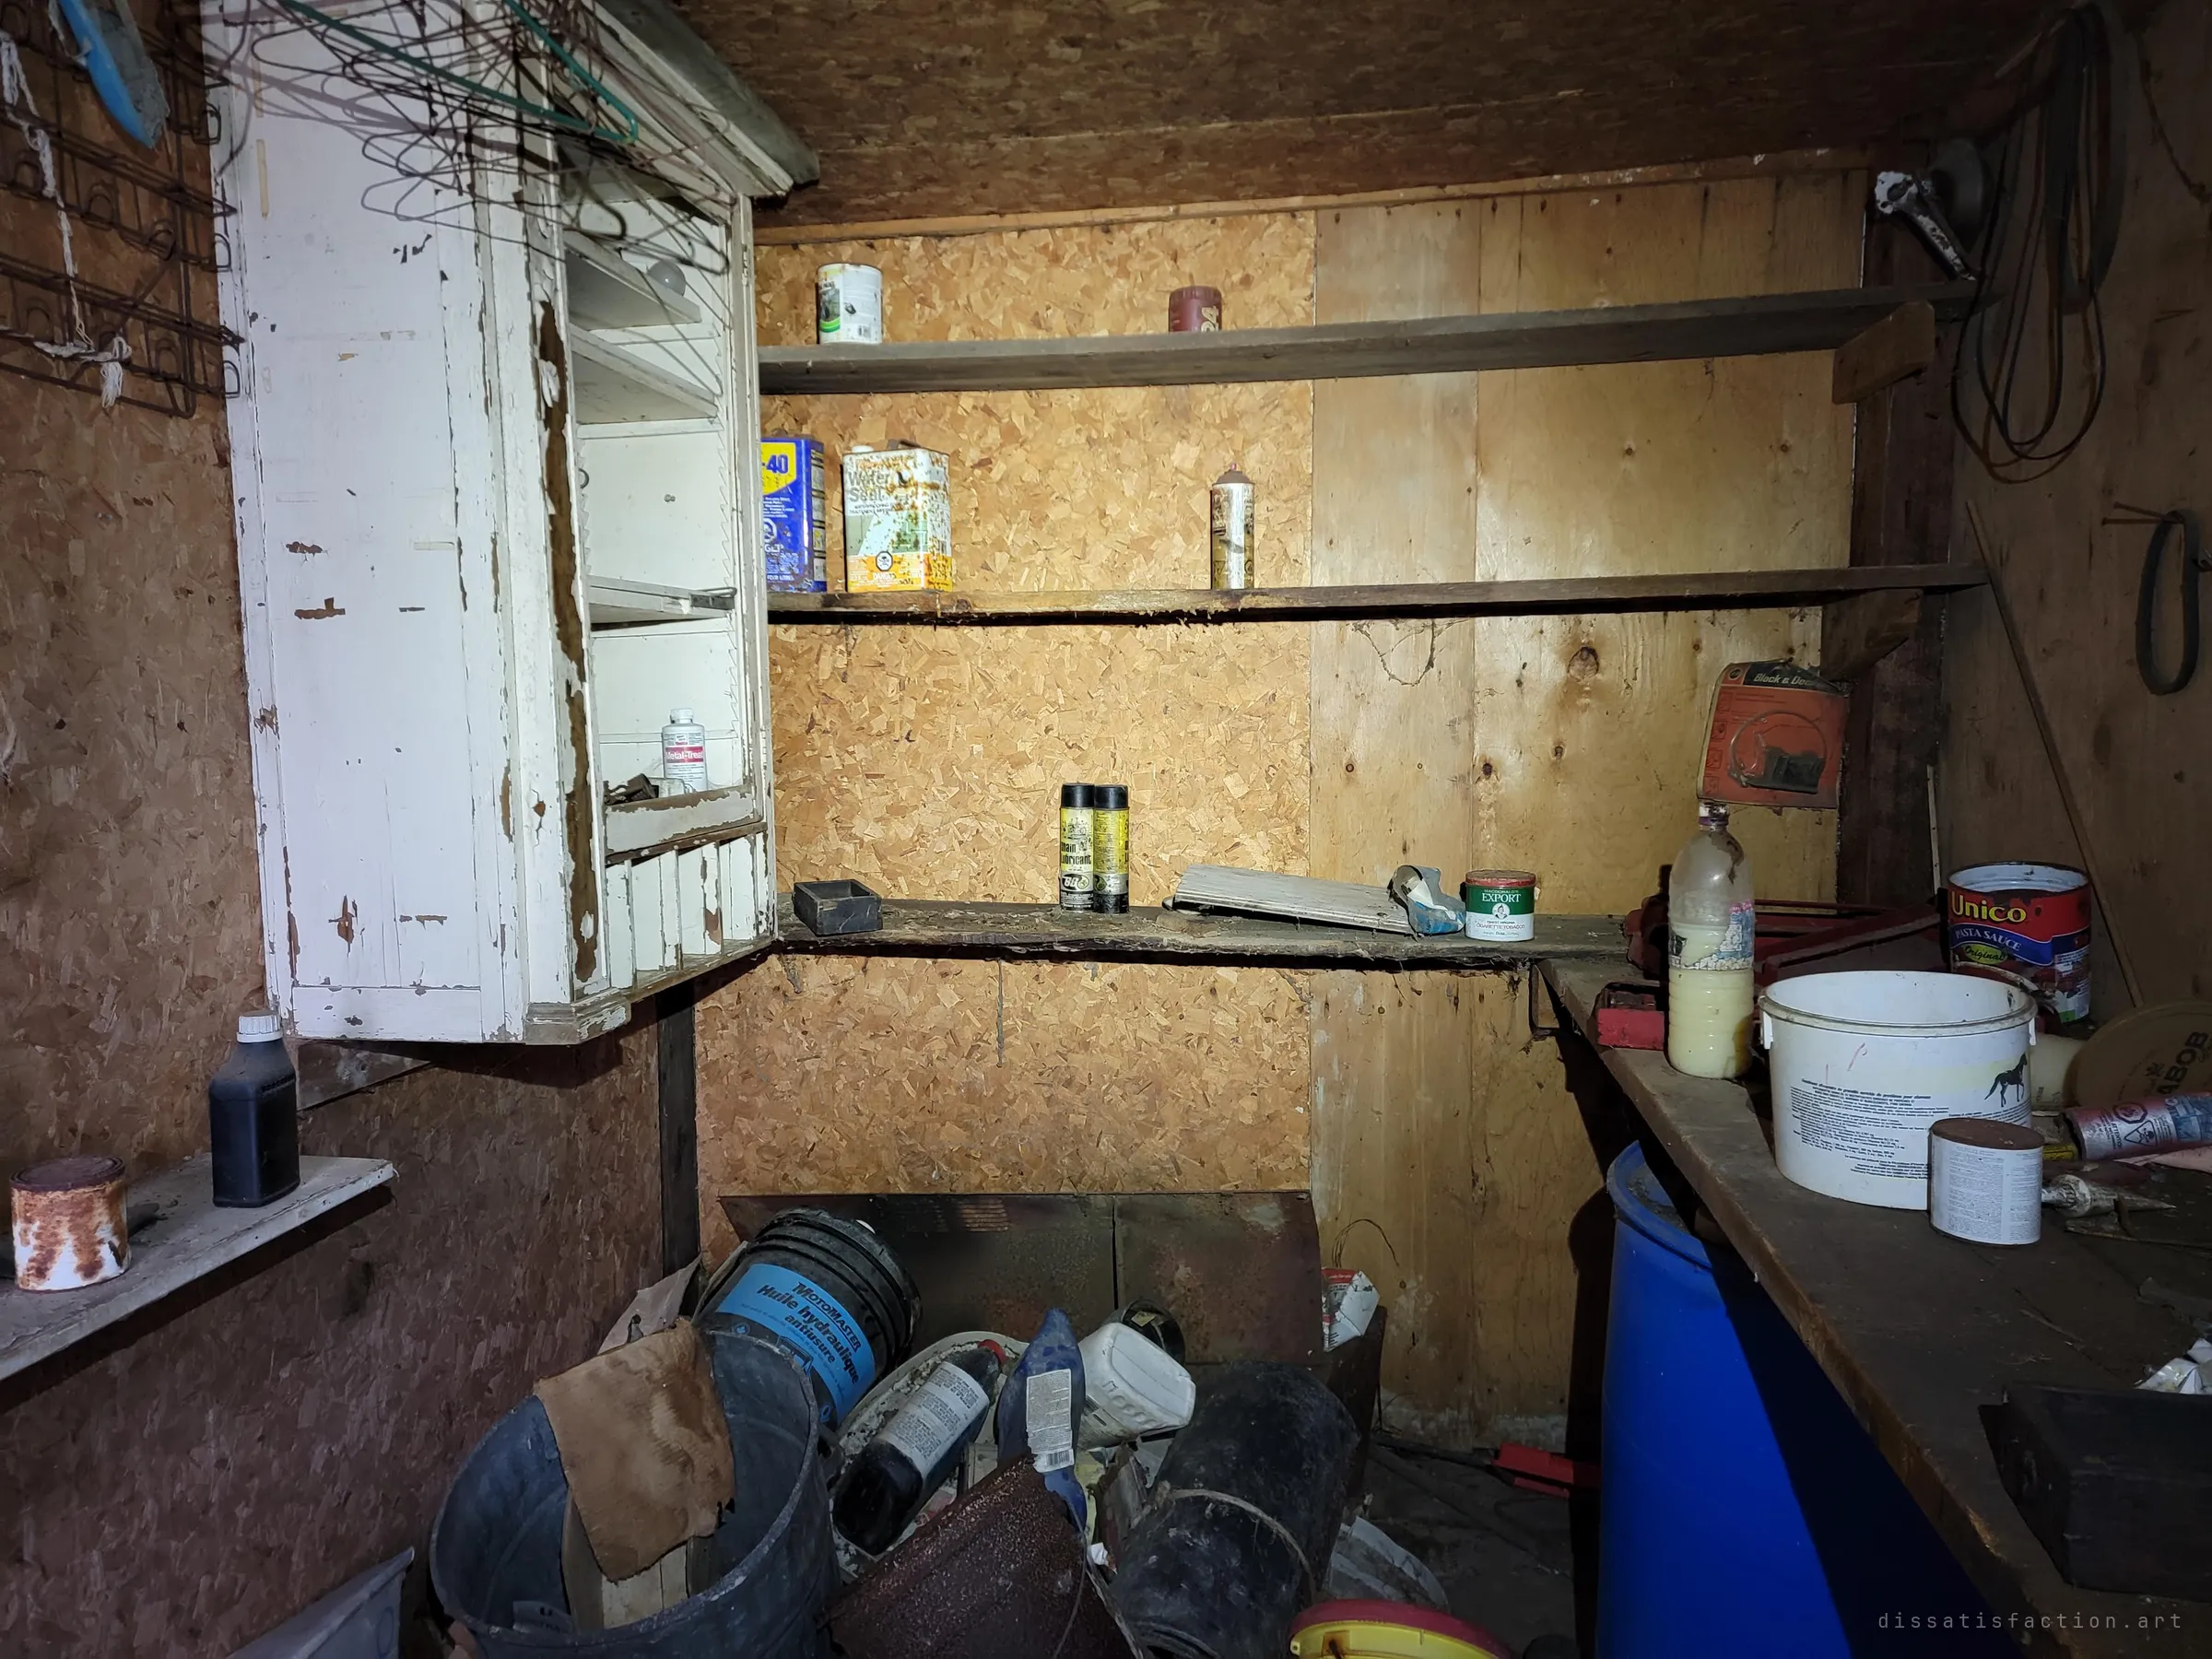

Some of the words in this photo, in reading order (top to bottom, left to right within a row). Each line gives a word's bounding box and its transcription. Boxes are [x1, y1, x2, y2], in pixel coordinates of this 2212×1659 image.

[1482, 893, 1522, 903] EXPORT
[1951, 891, 2027, 923] Unico
[1955, 927, 1983, 939] PASTA
[1983, 931, 2022, 951] SAUCE
[1964, 946, 2006, 961] Original
[2156, 1031, 2209, 1095] ABOB
[757, 1285, 799, 1310] Huile
[798, 1305, 860, 1385] hydraulique
[784, 1314, 836, 1364] antiusure
